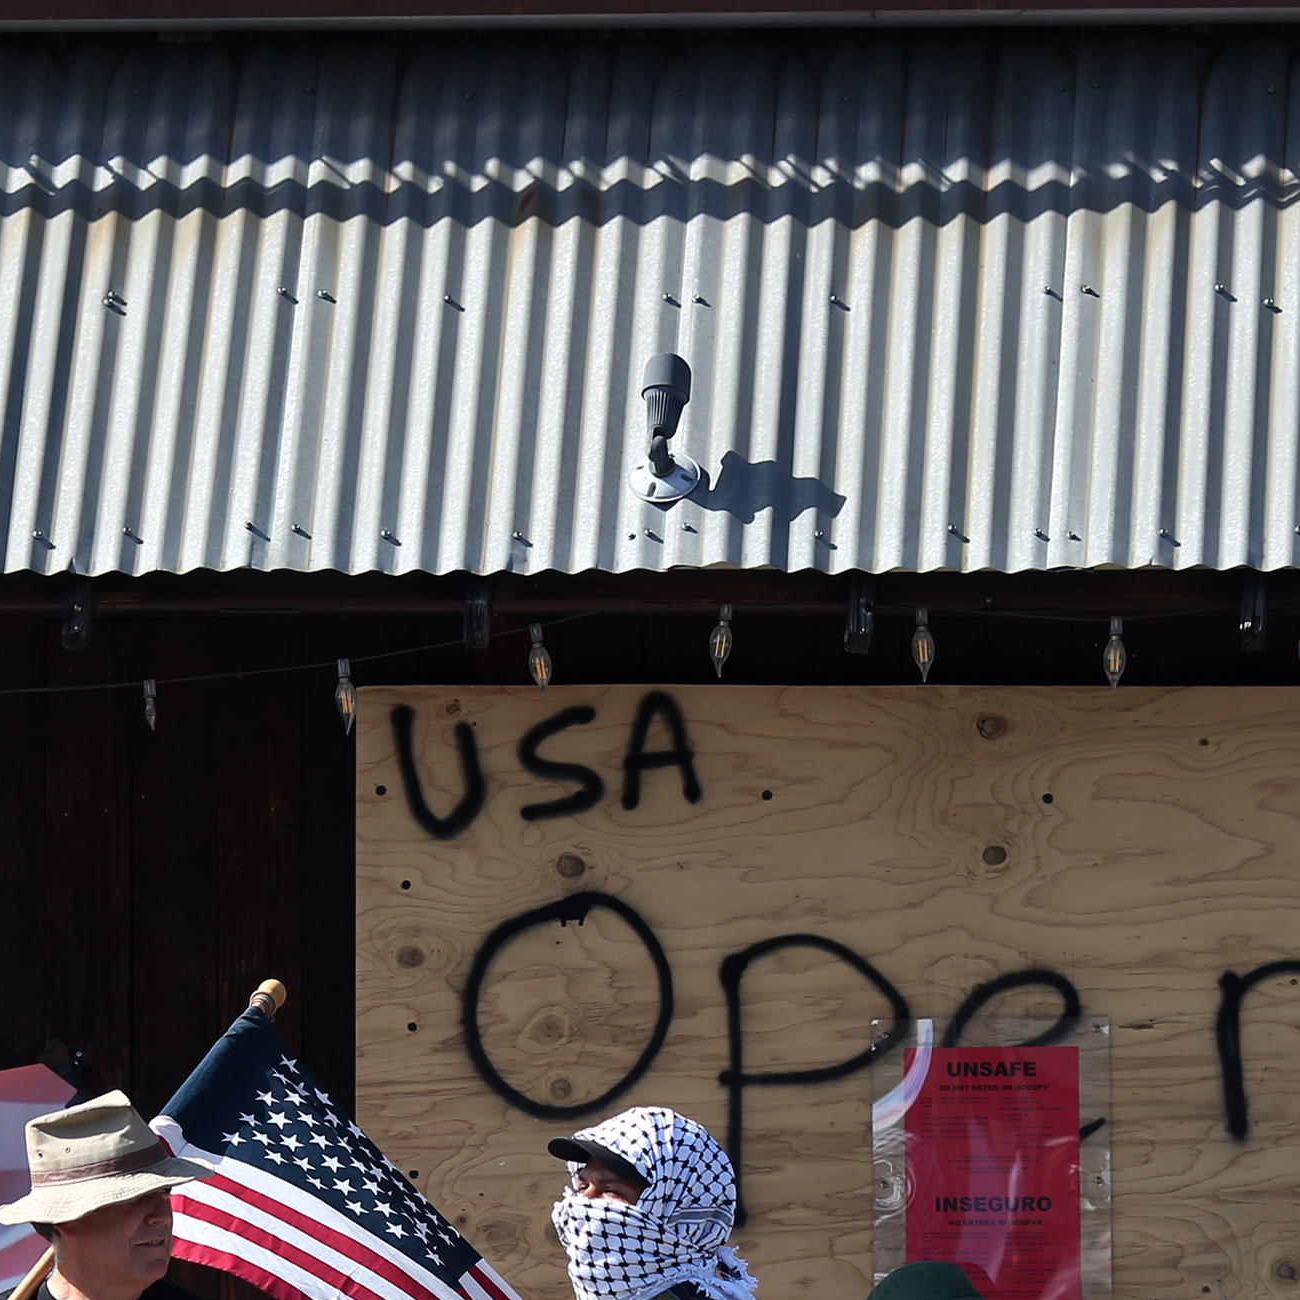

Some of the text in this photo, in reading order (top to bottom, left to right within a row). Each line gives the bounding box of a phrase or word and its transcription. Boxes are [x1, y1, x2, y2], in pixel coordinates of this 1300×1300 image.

[390, 691, 701, 839] USA
[947, 1061, 1037, 1078] UNSAFE
[939, 1084, 1049, 1092] DO NOT ENTER OR OCCUPY
[935, 1196, 1052, 1213] INSEGURO
[949, 1219, 961, 1227] NO
[962, 1219, 996, 1227] ENTRAR
[1009, 1219, 1043, 1227] OCUPAR
